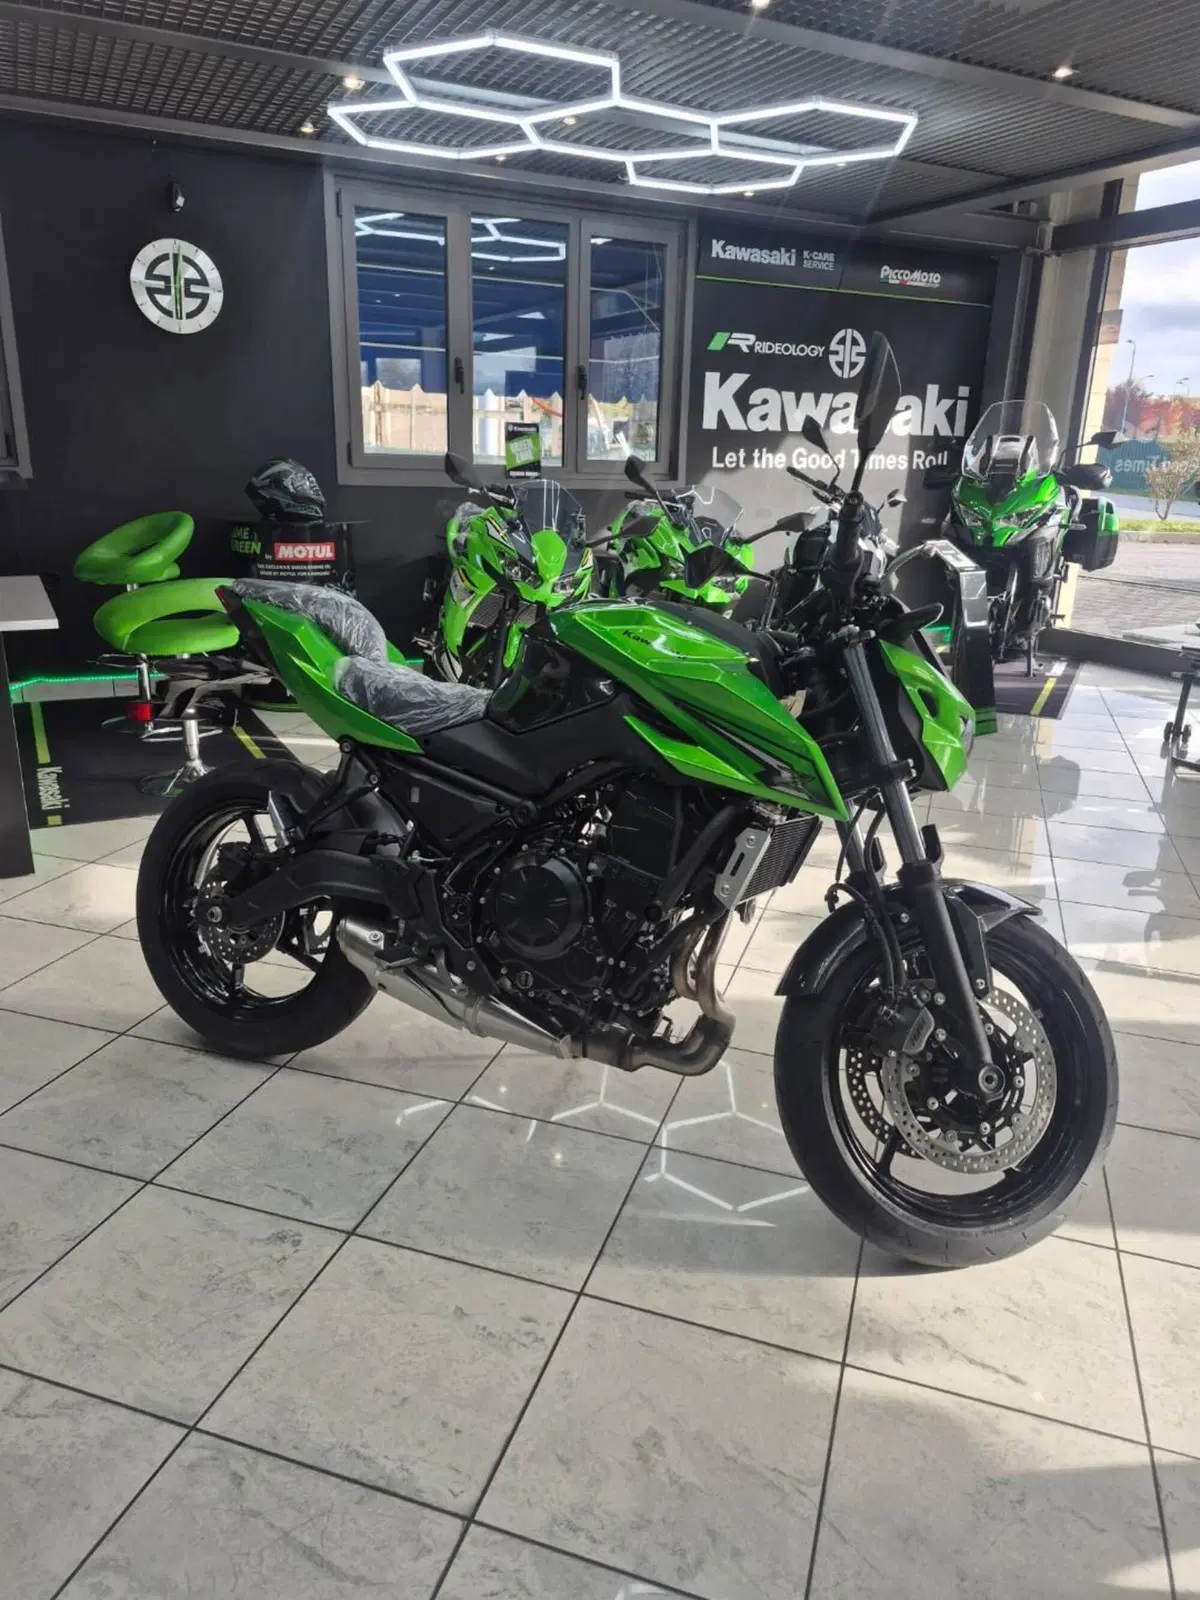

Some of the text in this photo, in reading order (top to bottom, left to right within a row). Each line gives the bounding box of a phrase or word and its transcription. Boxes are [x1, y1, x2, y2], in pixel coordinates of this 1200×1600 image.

[711, 239, 796, 267] Kawasaki
[803, 260, 834, 271] SERVICE
[754, 341, 825, 357] RIDEOLOGY
[702, 371, 970, 437] Kawaaki
[712, 446, 745, 469] Let
[753, 447, 787, 469] the
[791, 447, 846, 470] Good
[850, 449, 908, 470] Tmes
[278, 545, 333, 559] MOTUL
[36, 766, 71, 810] Kawasaki
